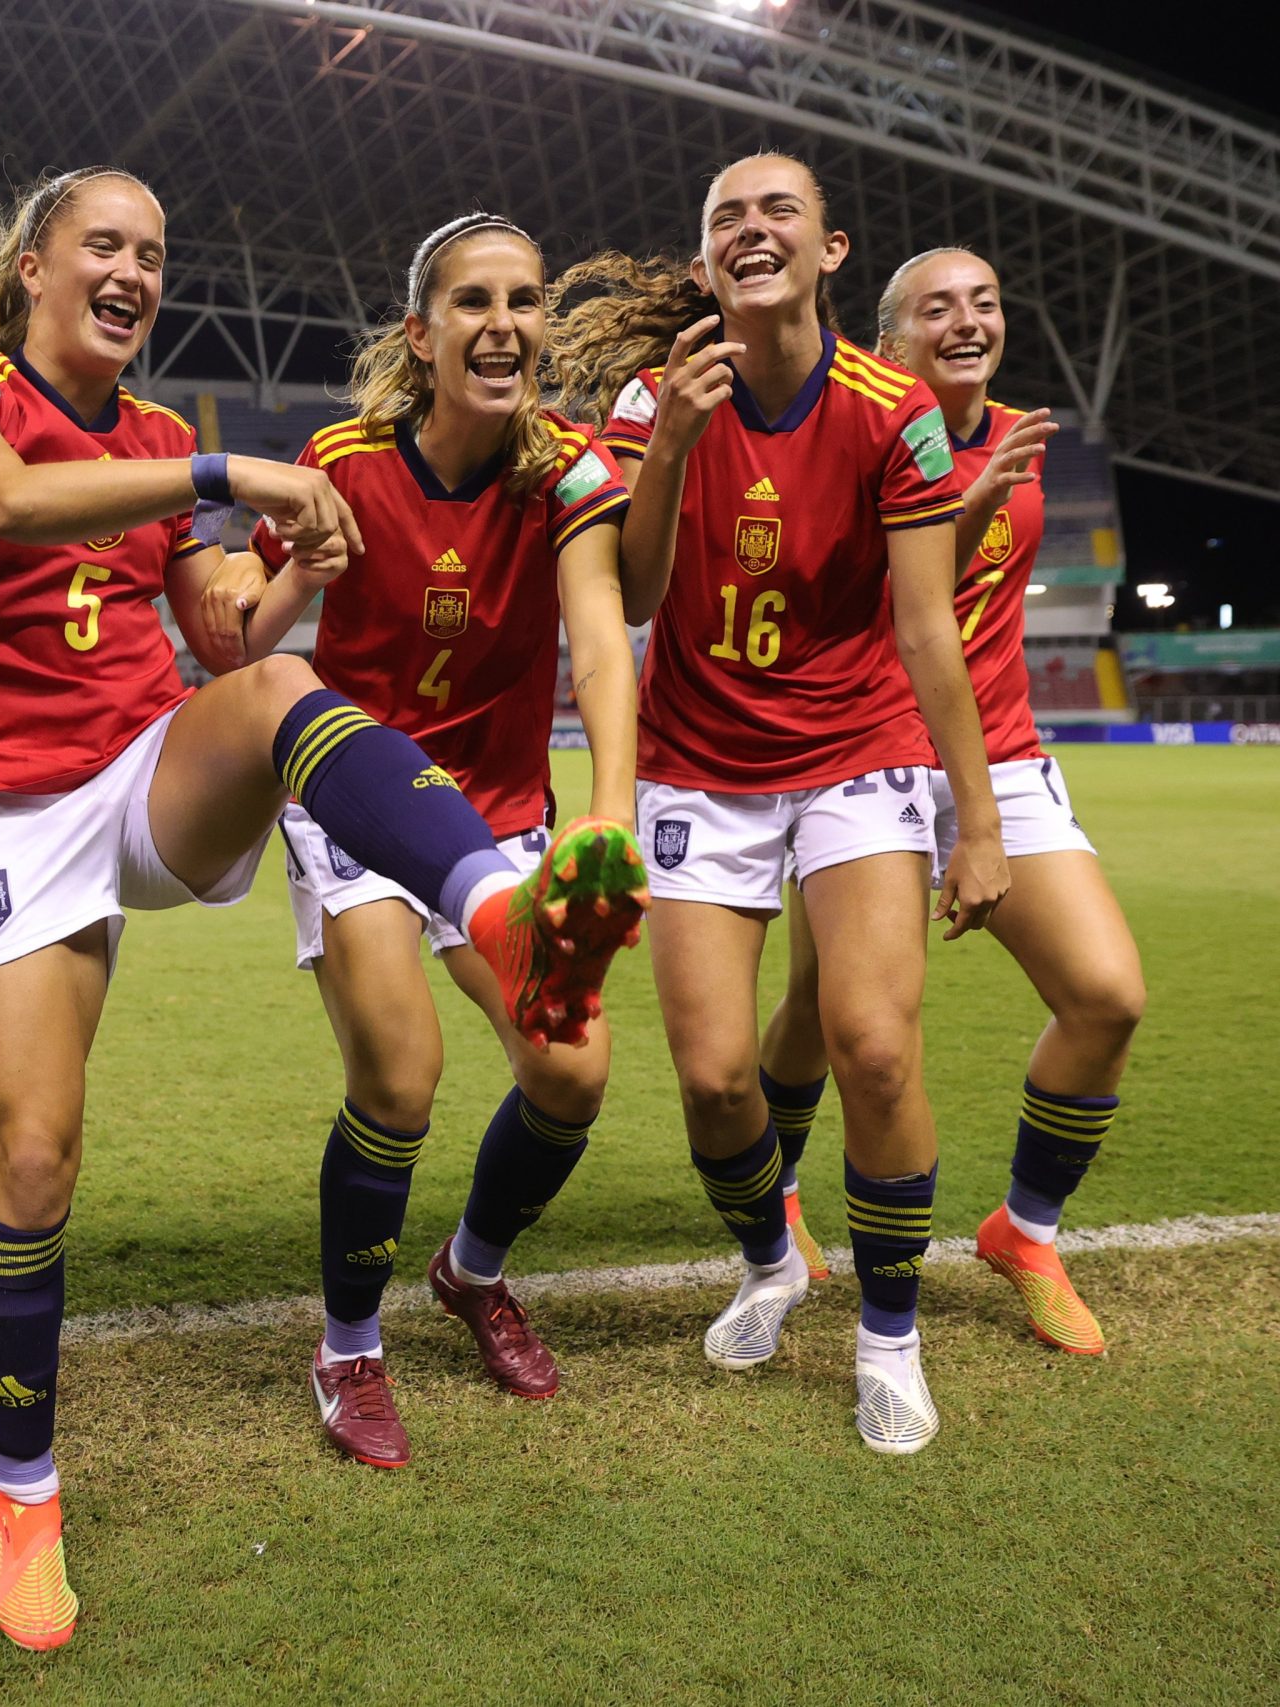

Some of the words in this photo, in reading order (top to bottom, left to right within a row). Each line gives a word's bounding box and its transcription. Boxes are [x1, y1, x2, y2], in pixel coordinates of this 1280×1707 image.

[744, 490, 780, 502] adidas
[431, 562, 468, 573] adidas
[64, 562, 112, 652] 5
[709, 584, 787, 668] 16
[960, 569, 1006, 642] 7
[417, 648, 453, 712] 4
